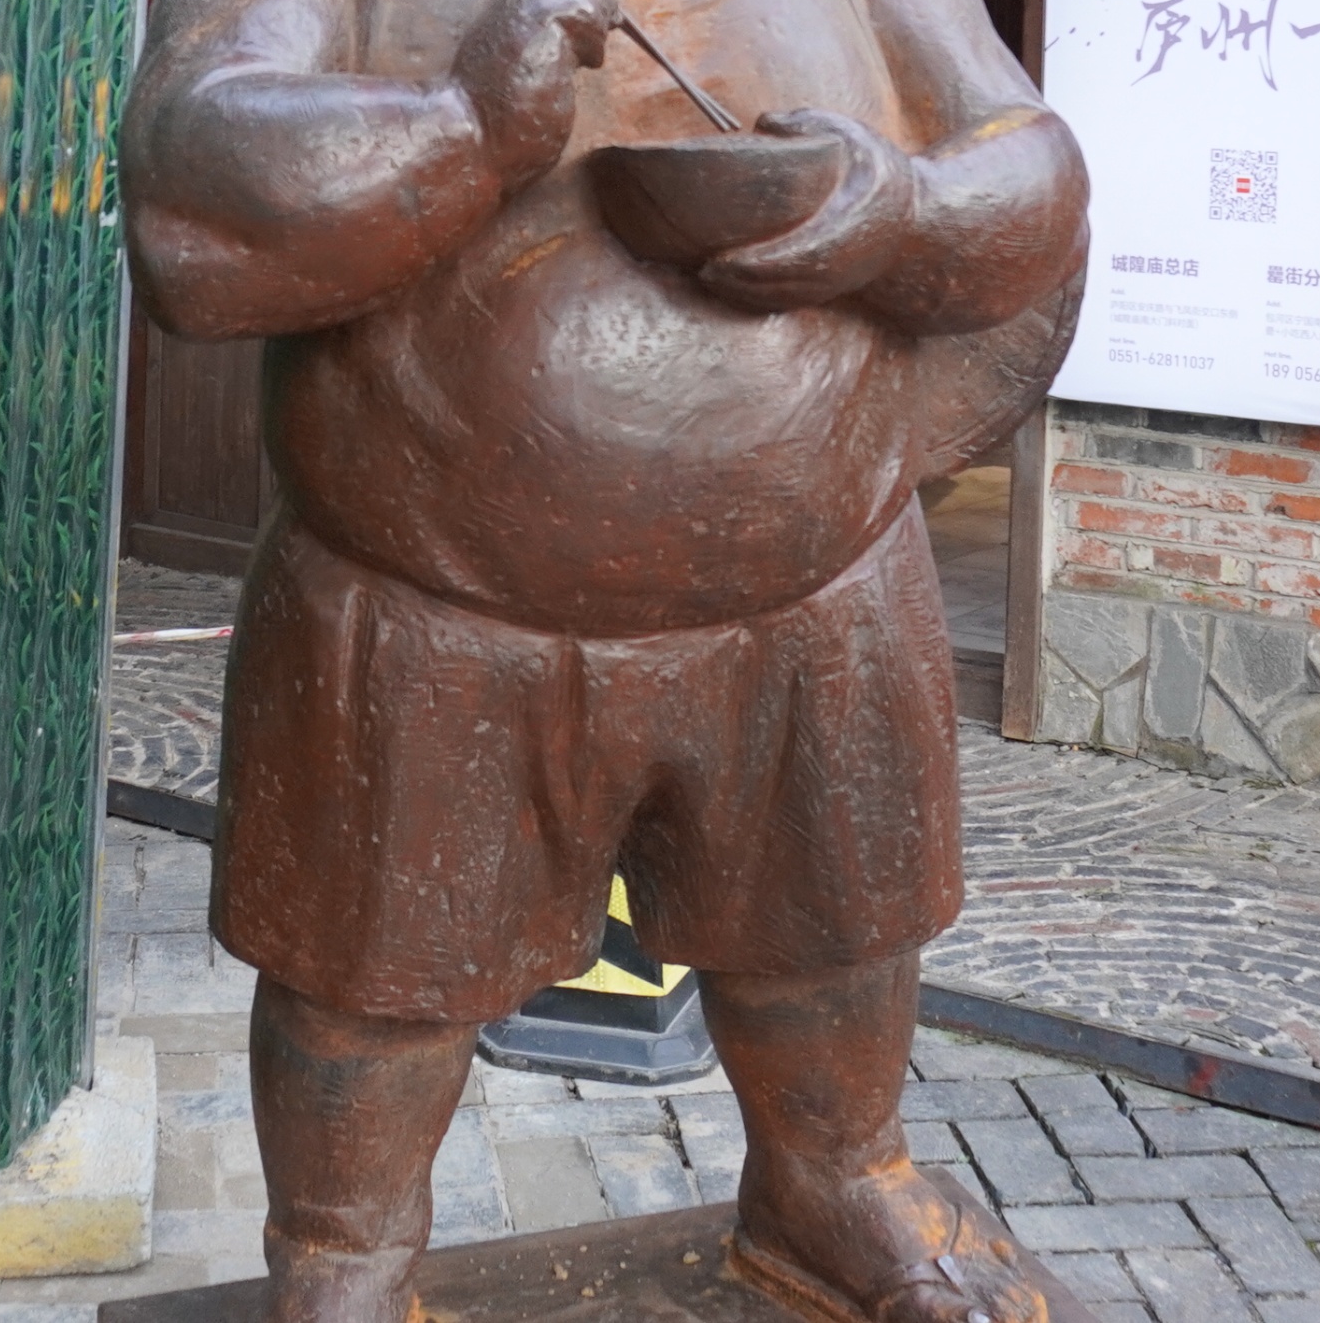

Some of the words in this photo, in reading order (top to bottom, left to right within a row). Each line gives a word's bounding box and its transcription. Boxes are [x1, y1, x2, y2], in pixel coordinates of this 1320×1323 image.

[1111, 254, 1200, 278] 城隍庙总店
[1109, 348, 1215, 370] 0551-62811037
[1264, 363, 1290, 379] 189
